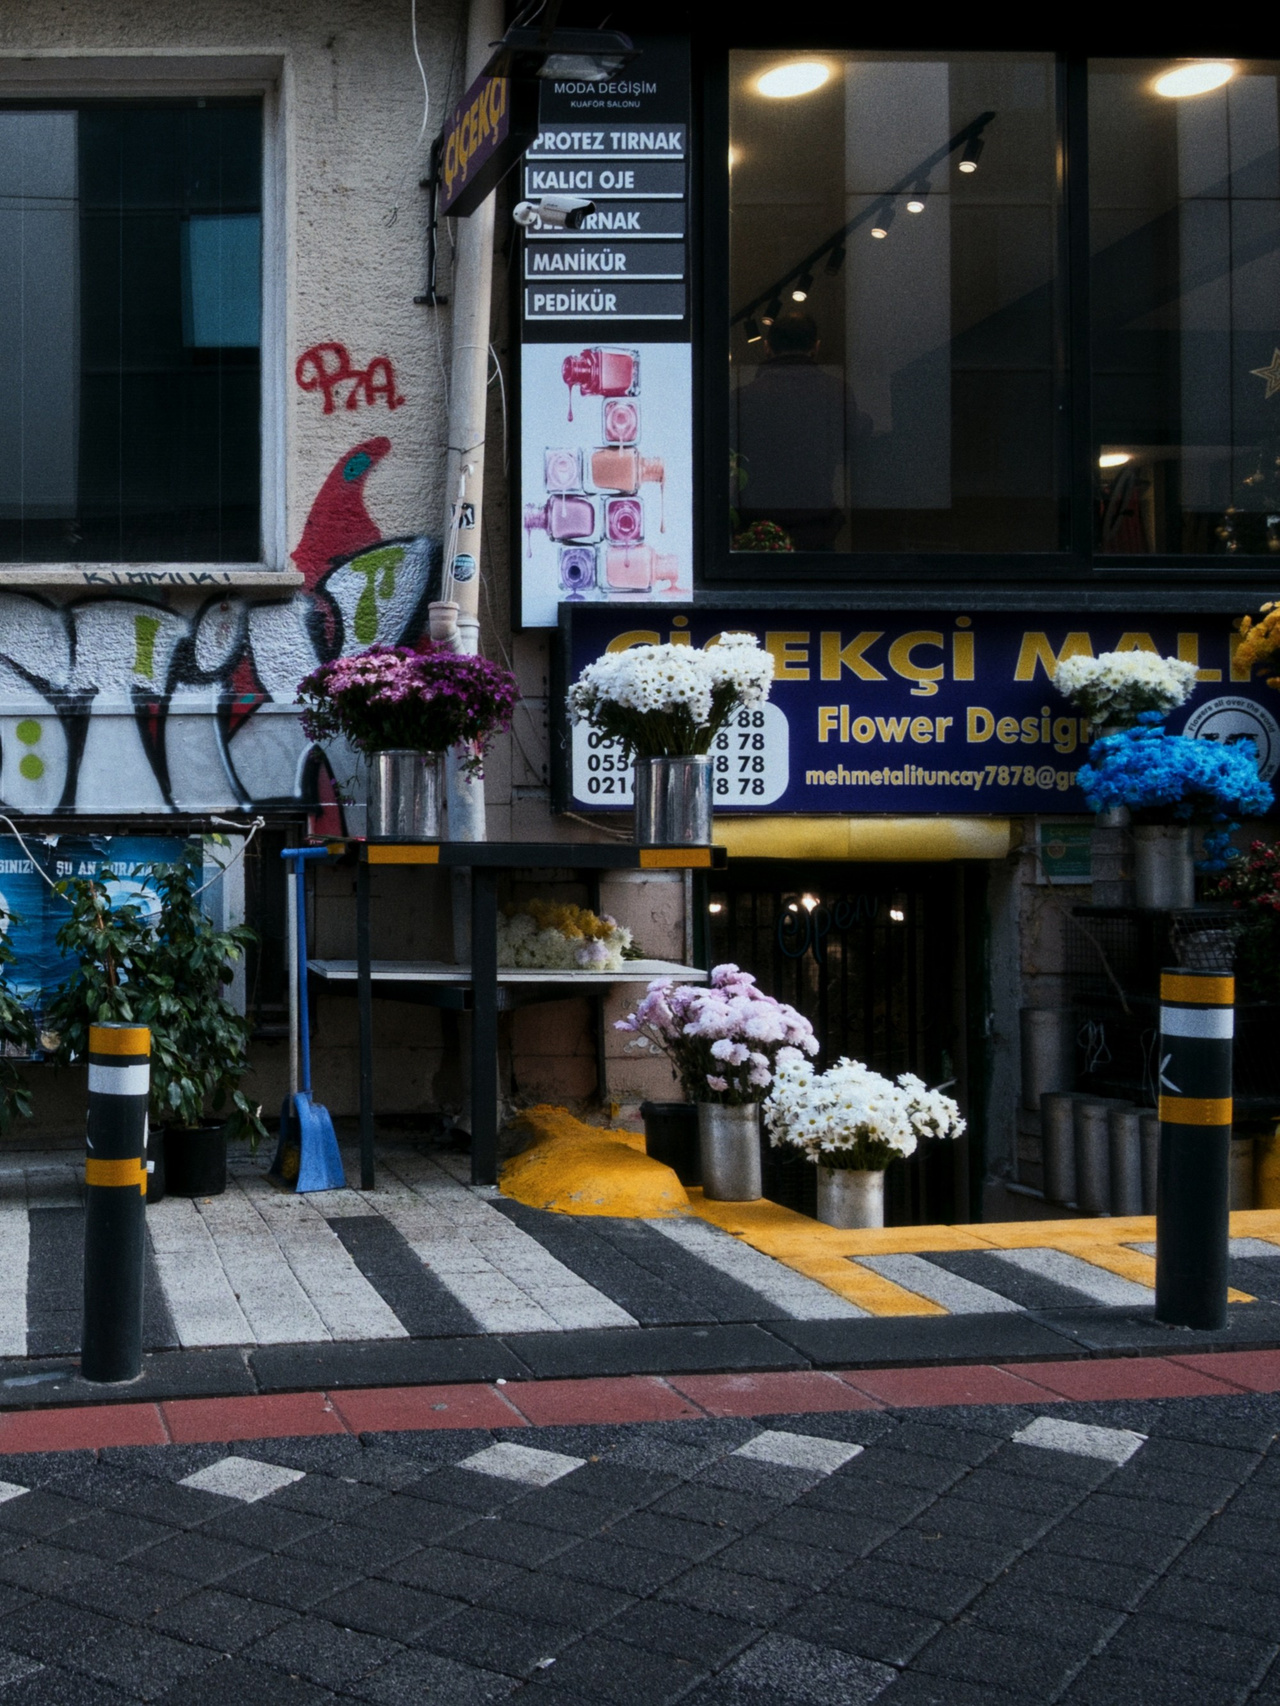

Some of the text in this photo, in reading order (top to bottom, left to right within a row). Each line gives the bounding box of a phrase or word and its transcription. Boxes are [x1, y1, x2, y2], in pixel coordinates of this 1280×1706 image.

[554, 80, 657, 97] MODA DEĞİŞİM
[570, 99, 640, 108] KUAFÖR SALONU
[532, 132, 682, 150] PROTEZ TIRNAK
[532, 171, 634, 189] KALICI OJE
[533, 248, 626, 271] MANİKÜR
[533, 288, 617, 311] PEDİKÜR
[606, 615, 975, 697] EKÇİ
[817, 704, 953, 744] Flower
[1188, 699, 1276, 733] Flowers all over the world
[738, 733, 765, 750] 78
[738, 755, 765, 773] 78
[587, 776, 634, 794] 021
[738, 777, 765, 795] 78
[56, 860, 73, 878] ŞU
[77, 861, 97, 875] AN
[777, 892, 879, 965] Open
